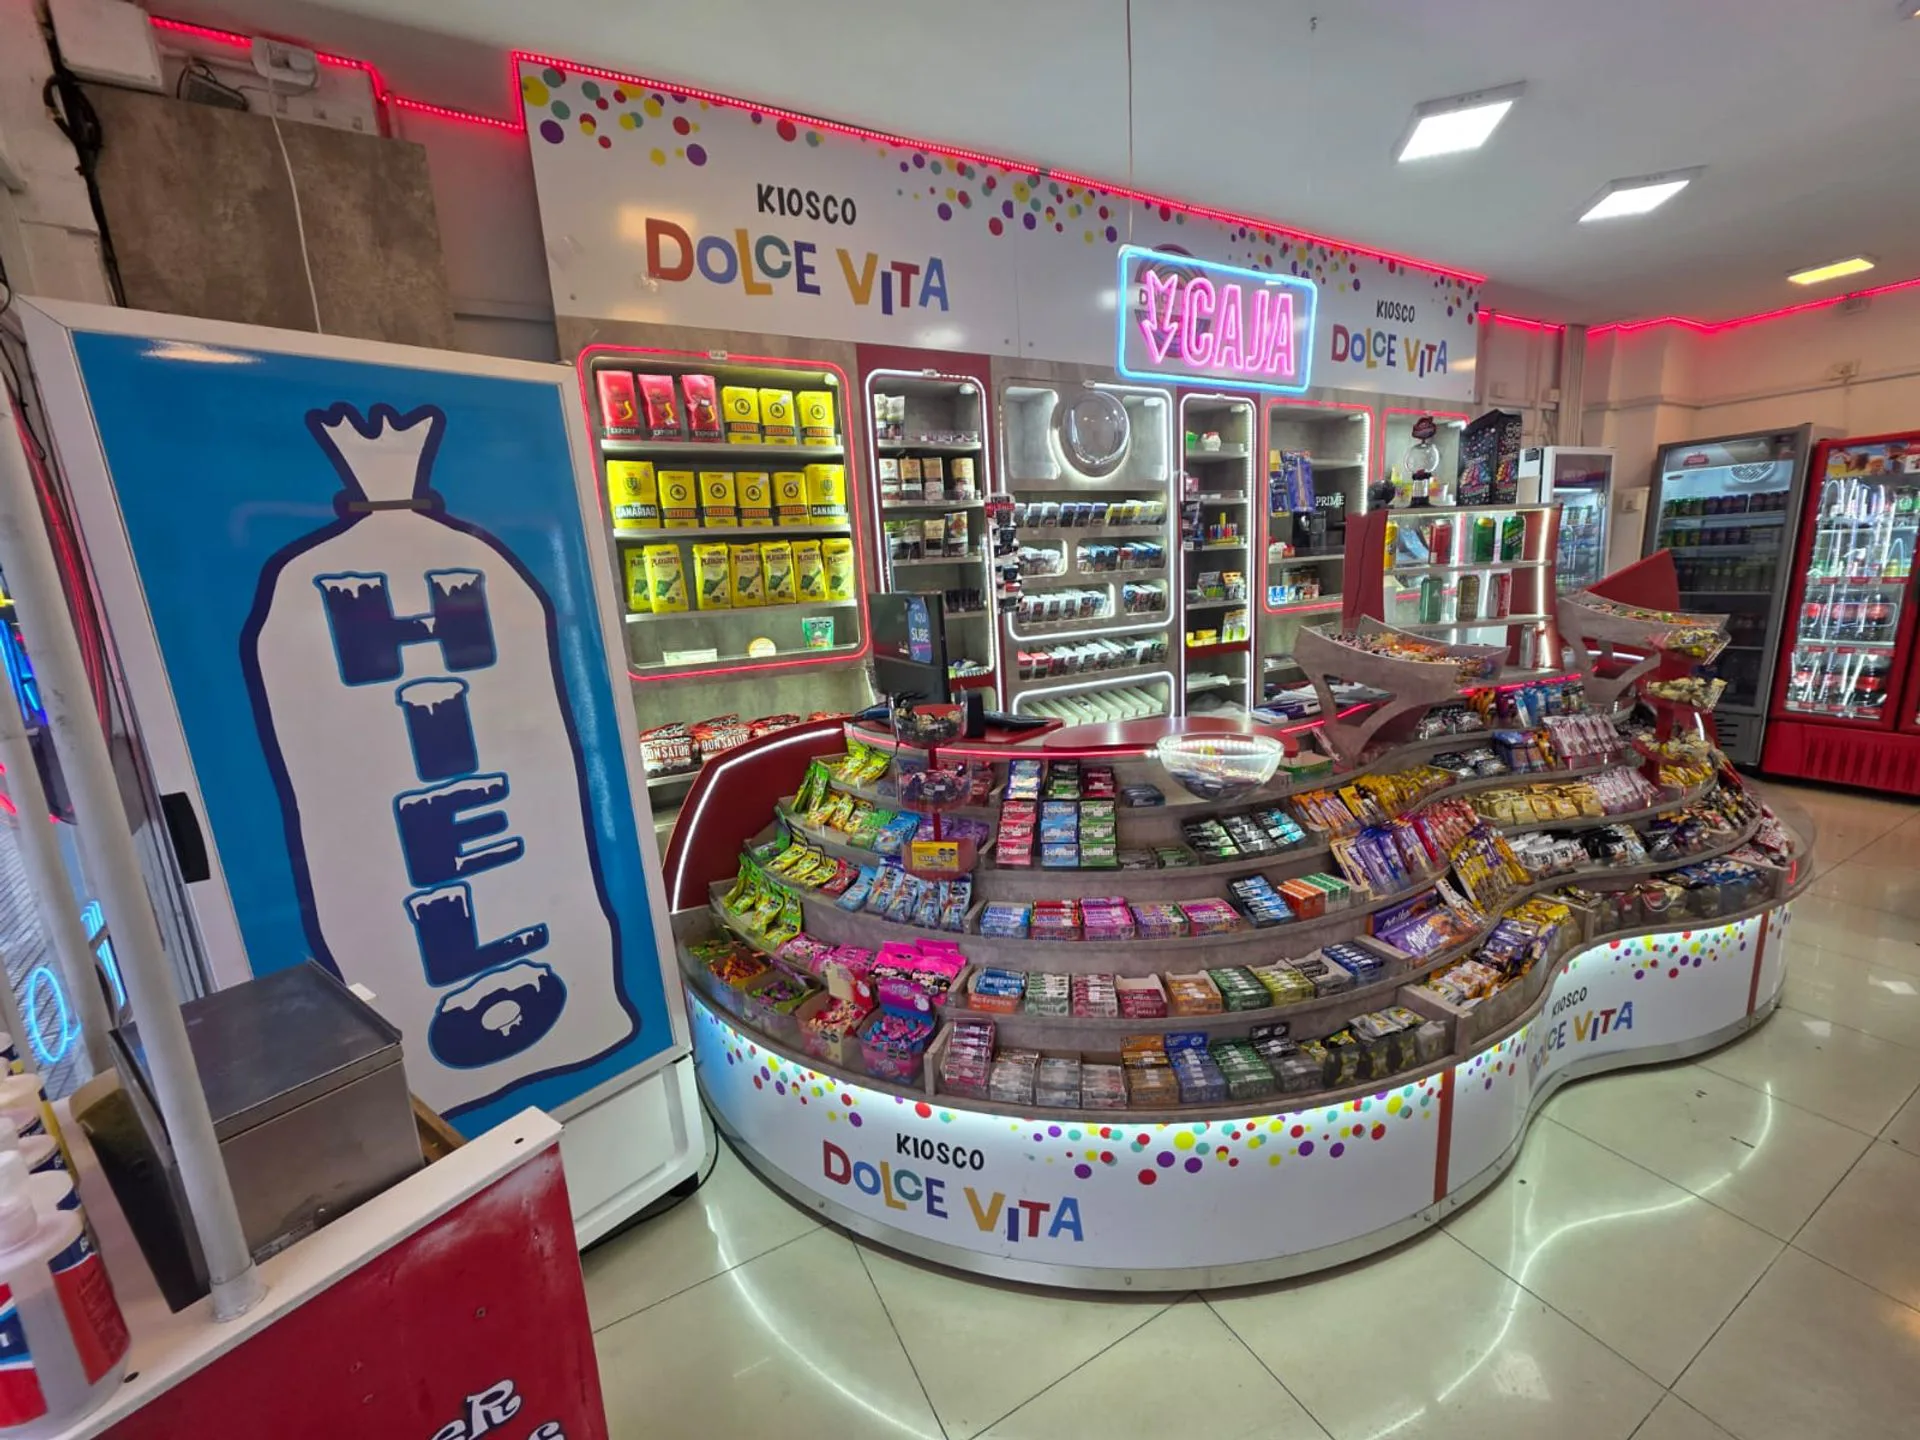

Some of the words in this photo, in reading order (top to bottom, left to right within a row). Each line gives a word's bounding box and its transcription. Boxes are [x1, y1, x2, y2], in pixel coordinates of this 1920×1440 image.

[757, 183, 857, 226] KIOSCO
[646, 217, 820, 296] DOLCE
[836, 248, 950, 315] VITA
[1181, 277, 1296, 377] CAJA
[1376, 300, 1416, 324] KIOSCO
[1331, 324, 1397, 369] DOLCE
[1404, 337, 1448, 378] VITA
[1315, 495, 1345, 507] PRIME
[911, 627, 929, 642] SUBE
[312, 568, 568, 1071] HIELO
[1551, 986, 1588, 1018] KIOSCO
[1573, 1001, 1633, 1042] VITA
[896, 1132, 985, 1171] KIOSCO
[822, 1139, 948, 1219] DOLCE
[963, 1186, 1085, 1242] VITA
